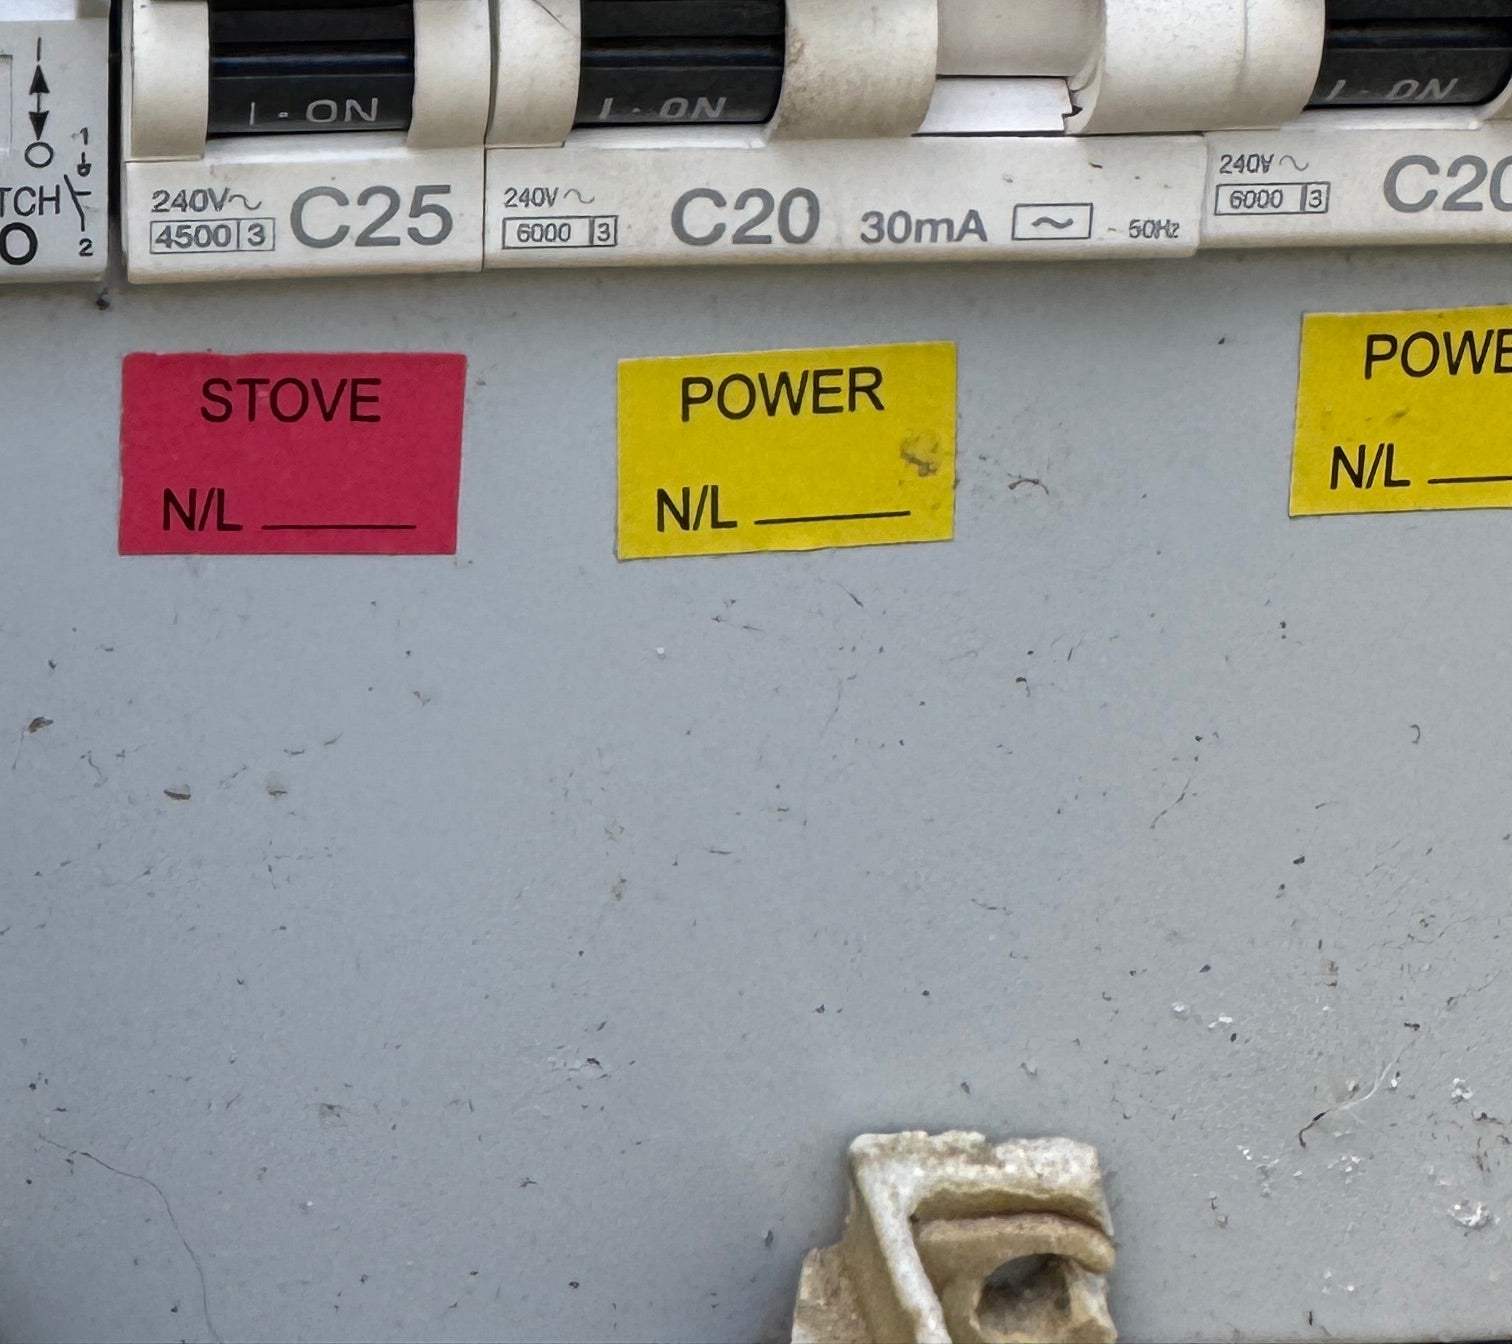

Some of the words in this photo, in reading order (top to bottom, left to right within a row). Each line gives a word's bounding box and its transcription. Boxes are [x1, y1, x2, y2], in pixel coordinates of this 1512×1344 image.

[1385, 78, 1460, 101] ON
[305, 97, 379, 123] ON
[658, 96, 728, 120] ON
[1229, 188, 1284, 210] 6000
[1308, 188, 1324, 209] 3
[289, 184, 453, 249] C25
[671, 187, 821, 246] C20
[860, 209, 988, 245] 30mA
[155, 223, 232, 249] 4500
[247, 222, 266, 248] 3
[516, 221, 573, 243] 6000
[596, 221, 611, 242] 3
[78, 238, 94, 257] 2
[200, 377, 383, 423] STOVE
[681, 366, 885, 423] POWER
[1330, 443, 1411, 490] N/L
[162, 487, 243, 531] N/L
[656, 484, 738, 532] N/L
